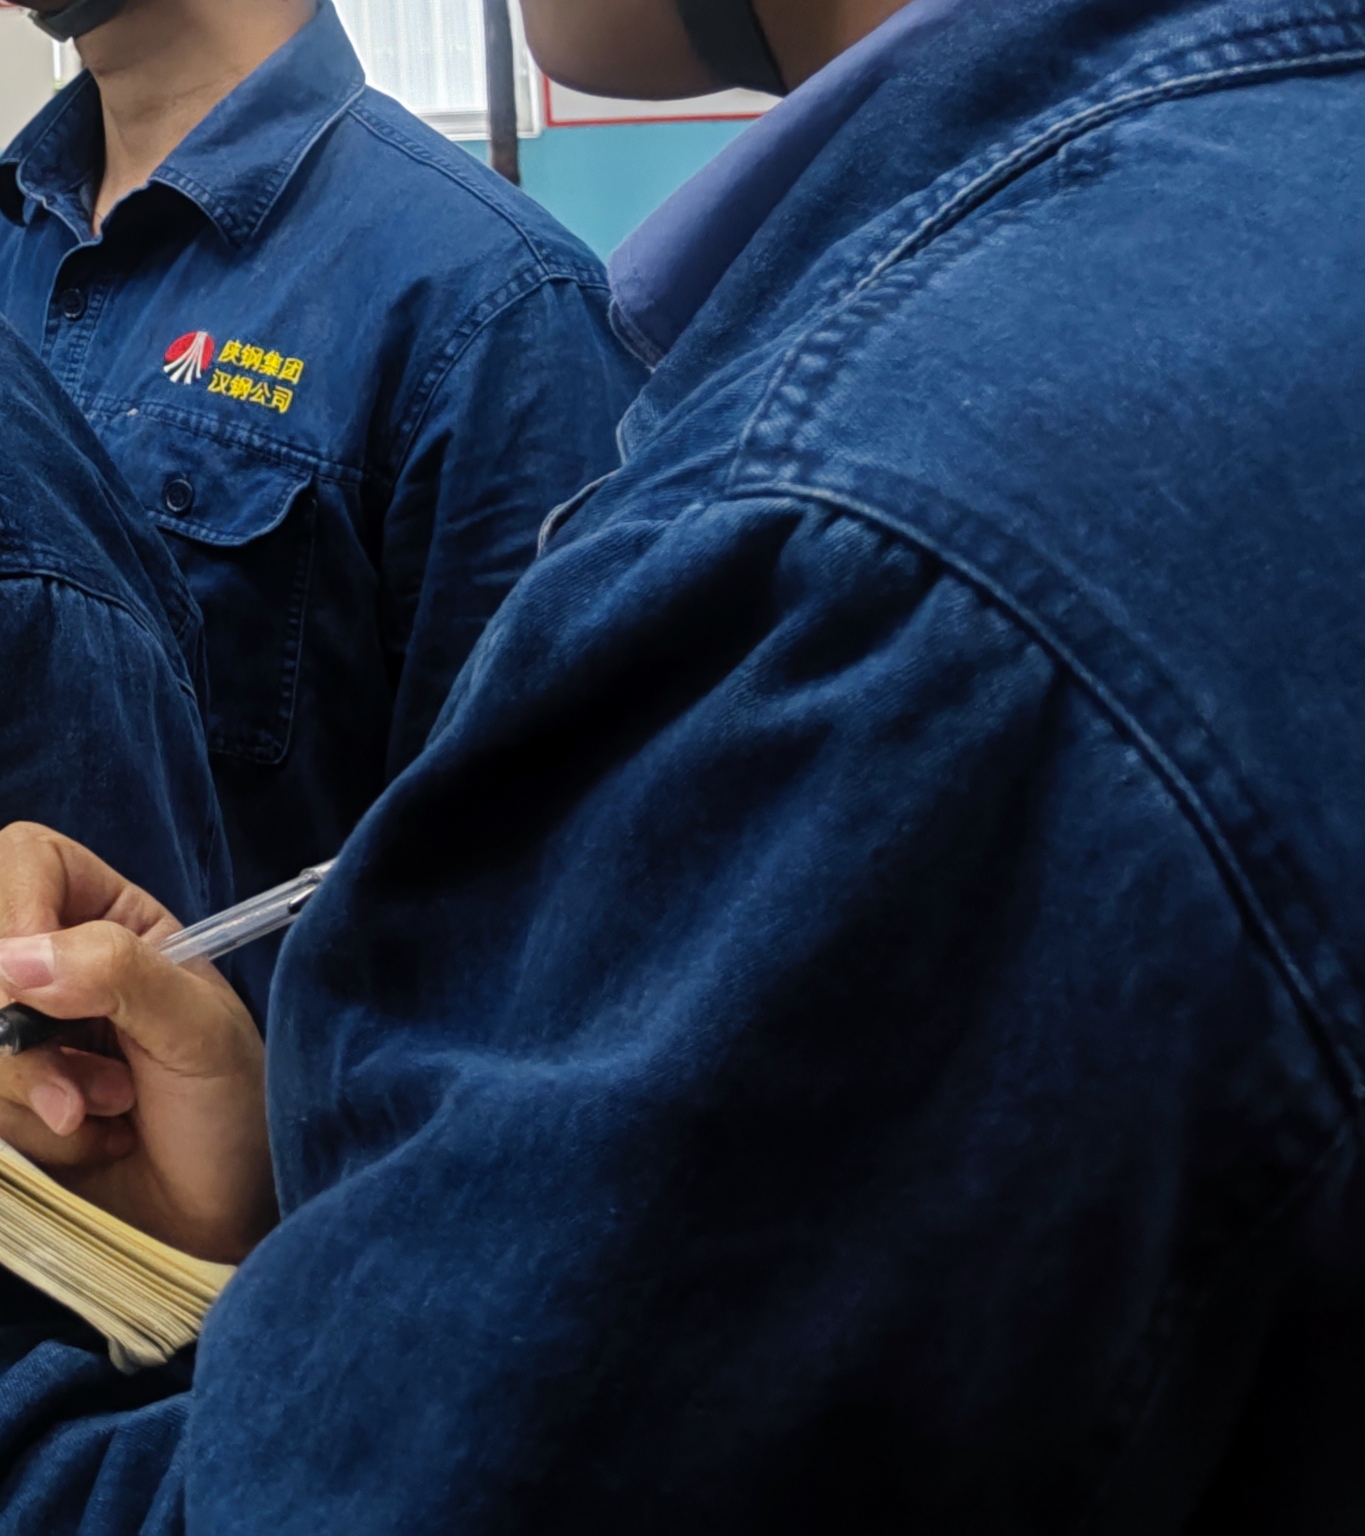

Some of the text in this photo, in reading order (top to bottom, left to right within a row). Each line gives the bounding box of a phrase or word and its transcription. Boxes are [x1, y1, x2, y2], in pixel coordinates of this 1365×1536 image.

[218, 339, 304, 385] 陕钢集团
[206, 368, 293, 414] 汉钢公司
